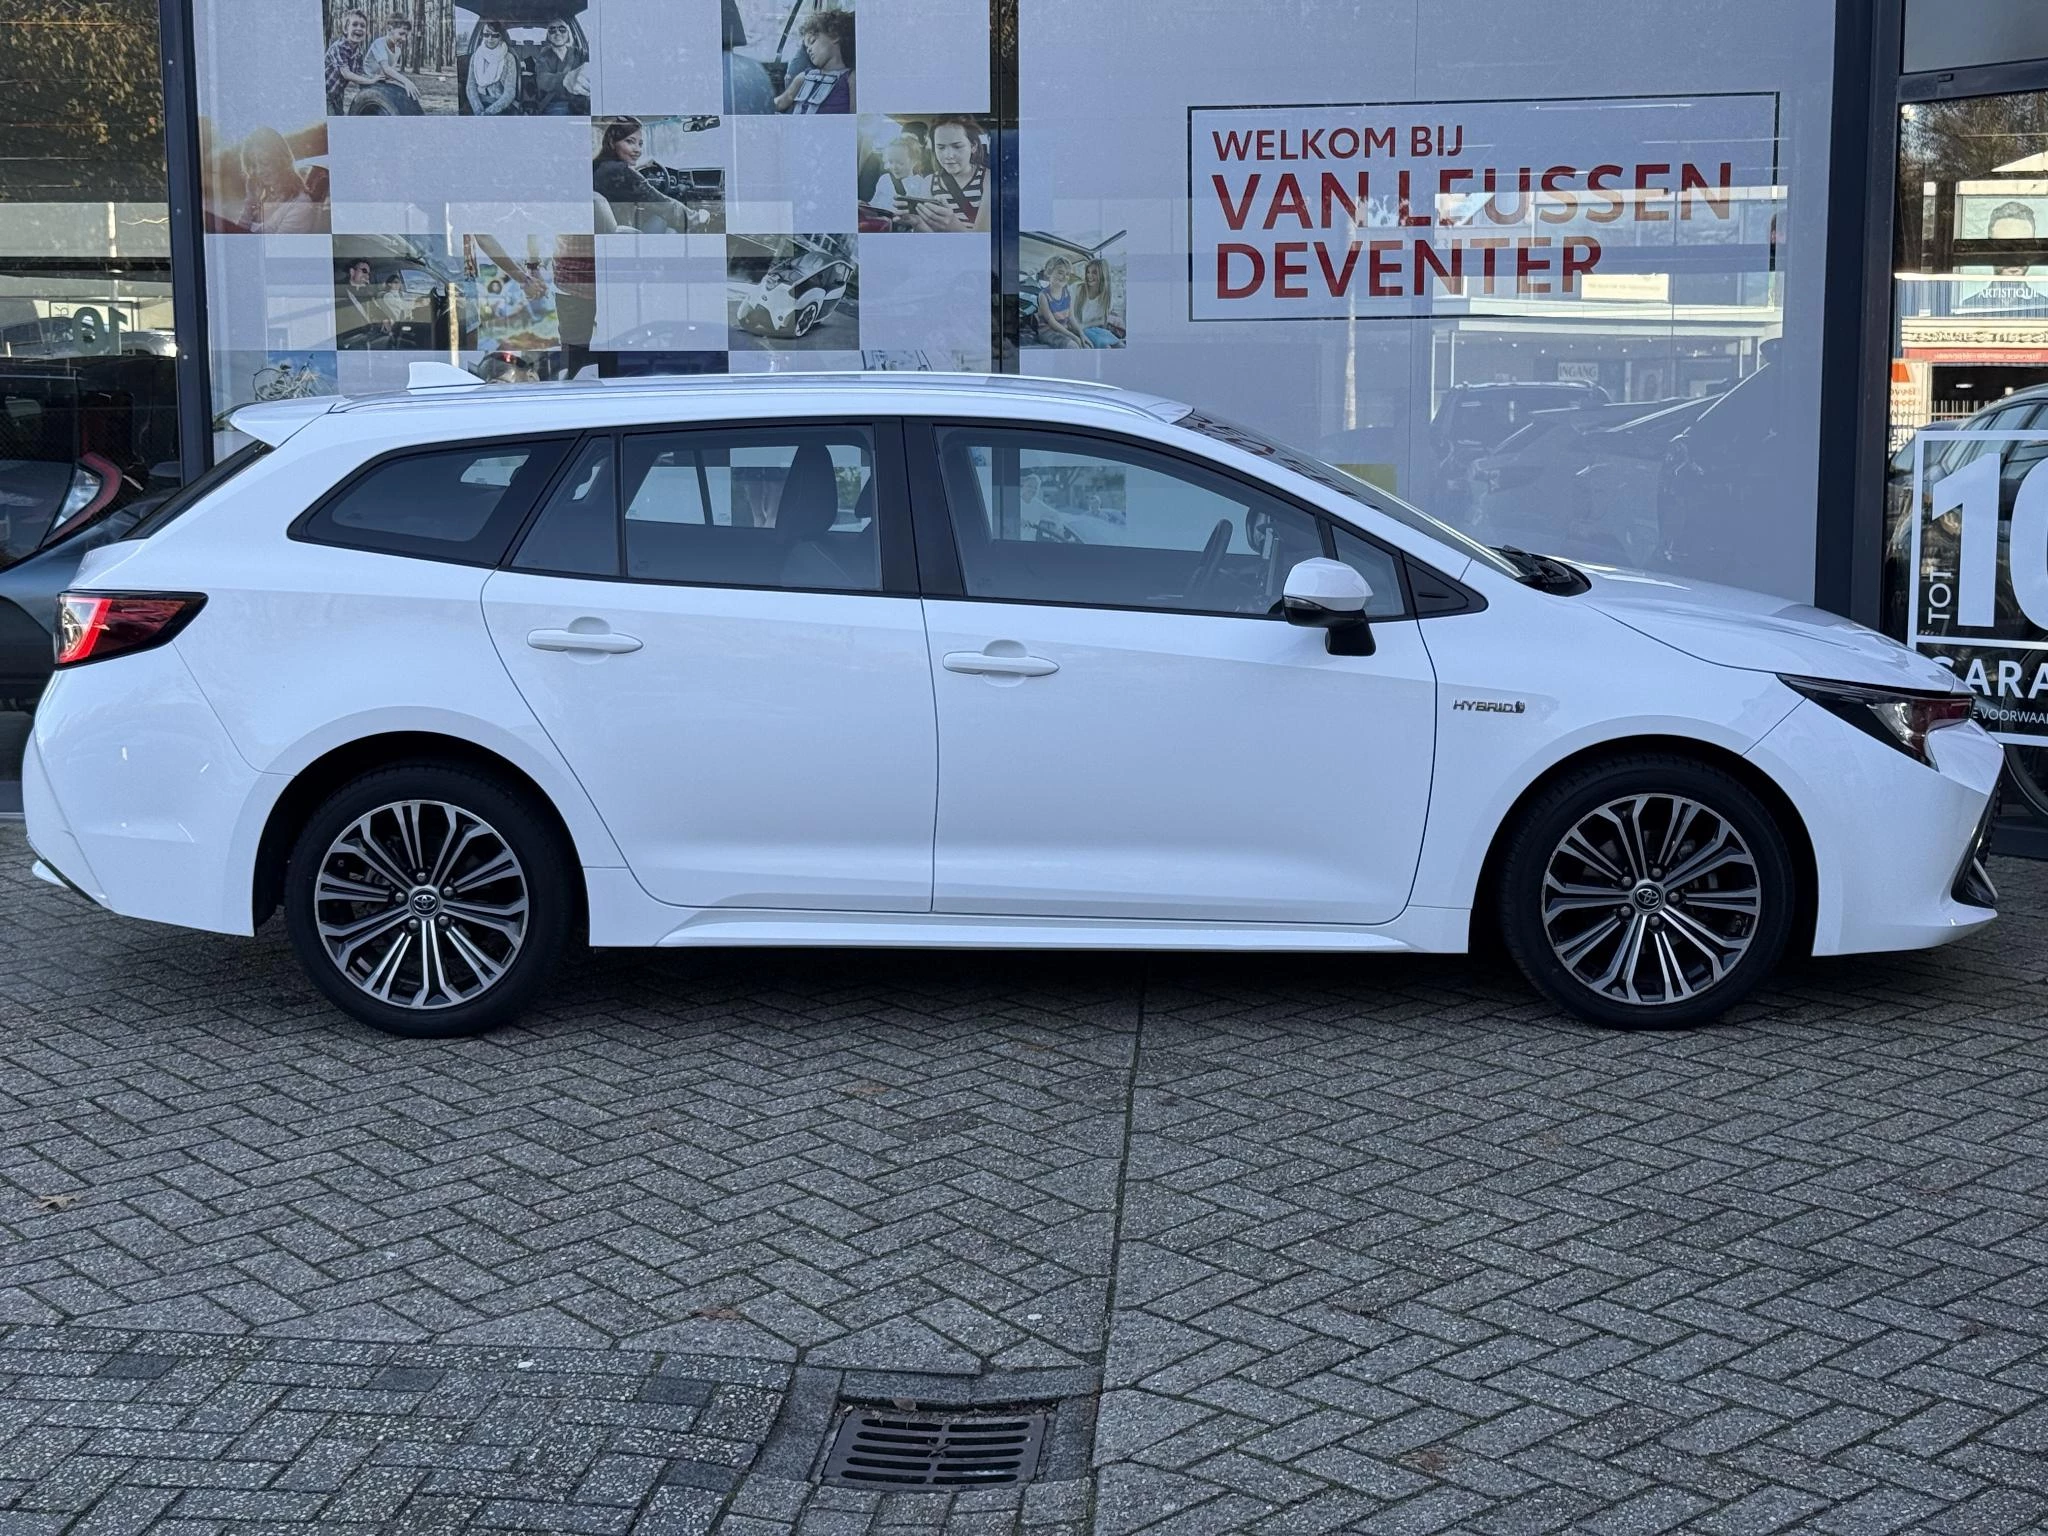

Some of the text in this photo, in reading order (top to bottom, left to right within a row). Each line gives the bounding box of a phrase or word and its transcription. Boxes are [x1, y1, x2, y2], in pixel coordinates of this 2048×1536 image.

[1212, 125, 1463, 161] WELKOM BIJ
[1211, 162, 1731, 231] VAN LEUSSEN
[1217, 236, 1602, 299] DEVENTER
[1928, 566, 1952, 624] TOT
[1932, 656, 2048, 699] ARA
[1453, 700, 1514, 713] HYBRID
[1981, 707, 2048, 724] VOORWAA
